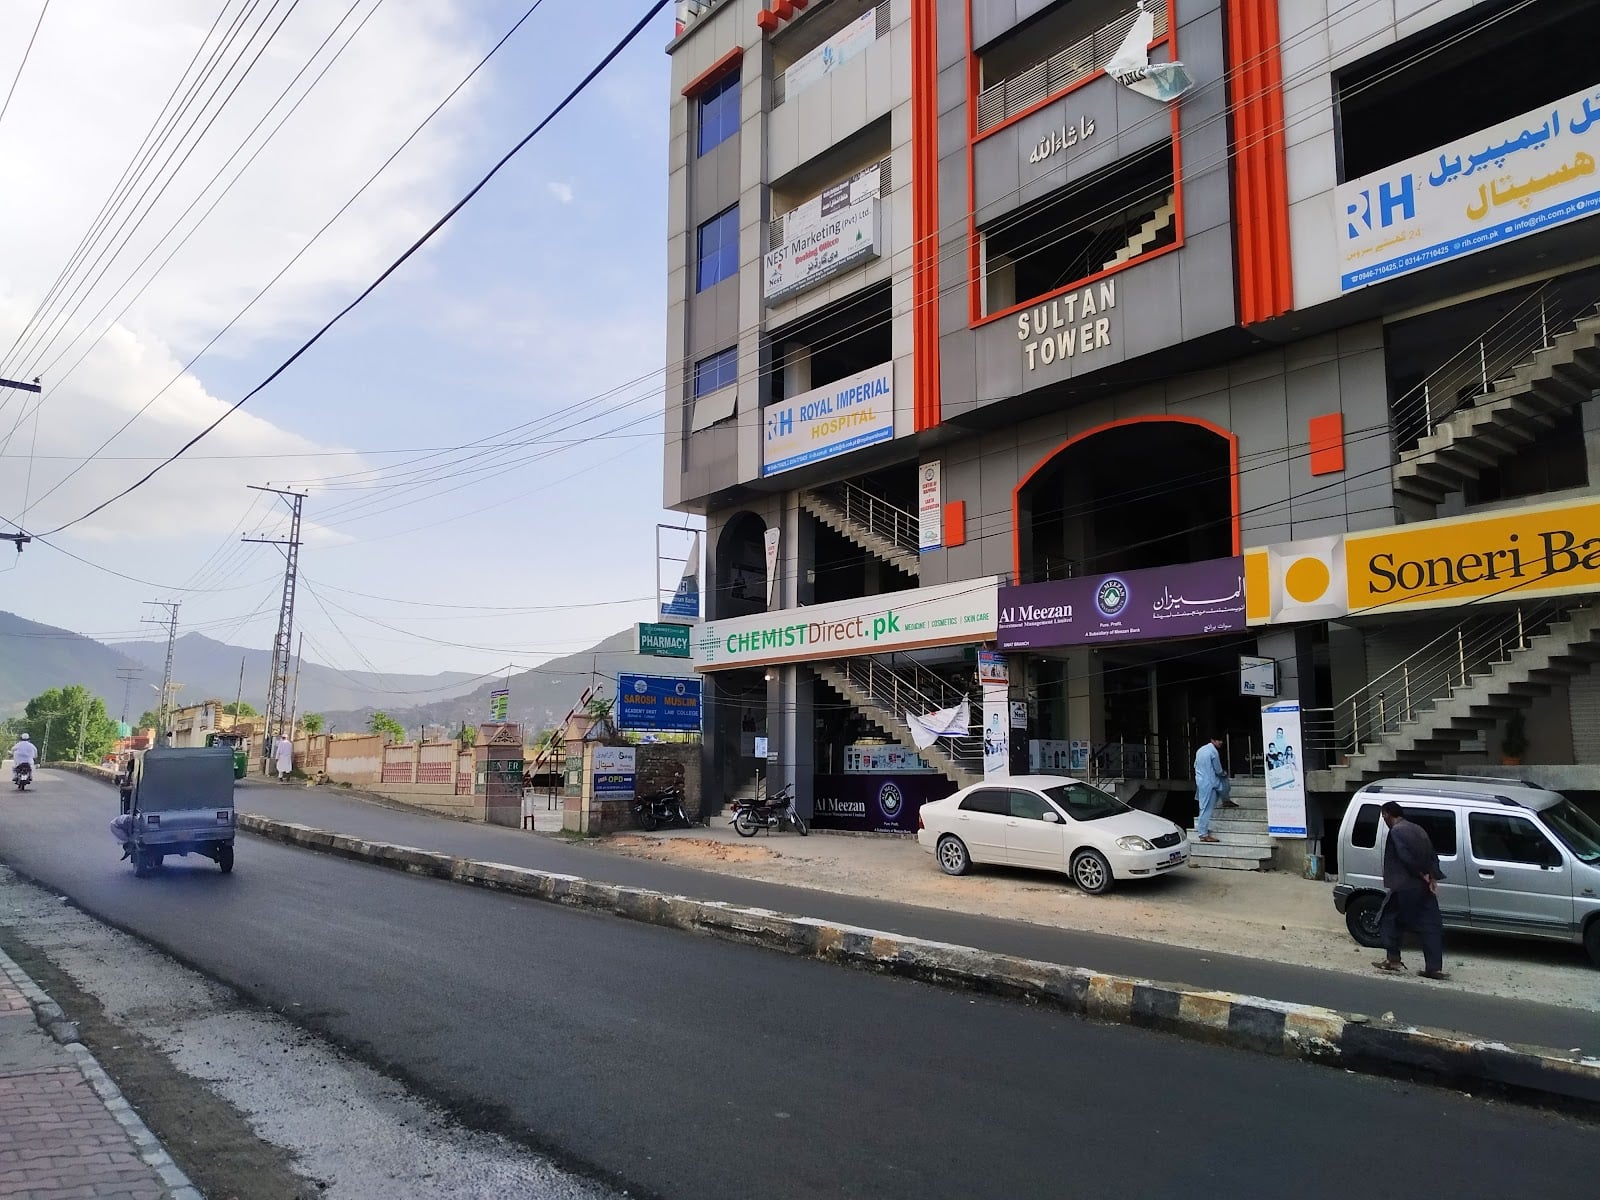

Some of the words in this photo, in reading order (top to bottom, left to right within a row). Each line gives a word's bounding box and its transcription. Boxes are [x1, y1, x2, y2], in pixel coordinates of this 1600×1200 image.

[1461, 229, 1499, 248] rih.com.pk
[1514, 205, 1576, 231] info@rih.com.pk
[766, 244, 792, 268] NEST
[791, 220, 841, 255] Marketing
[1017, 279, 1116, 341] SULTAN
[1025, 317, 1111, 370] TOWER
[800, 396, 833, 423] ROYAL
[836, 376, 890, 411] IMPERIAL
[811, 407, 876, 439] HOSPITAL
[1368, 534, 1525, 594] Soneri
[904, 622, 926, 630] MEDICINE
[931, 617, 957, 628] COSMETICS
[964, 615, 976, 623] SKIN
[976, 612, 990, 621] CARE
[998, 607, 1015, 623] Al
[1018, 605, 1073, 621] Meezan
[641, 635, 688, 649] PHARMACY
[624, 694, 657, 704] SAROSH
[664, 696, 697, 706] MUSLIM
[608, 775, 624, 783] OPD
[815, 798, 826, 811] Al
[828, 798, 866, 812] Meezan
